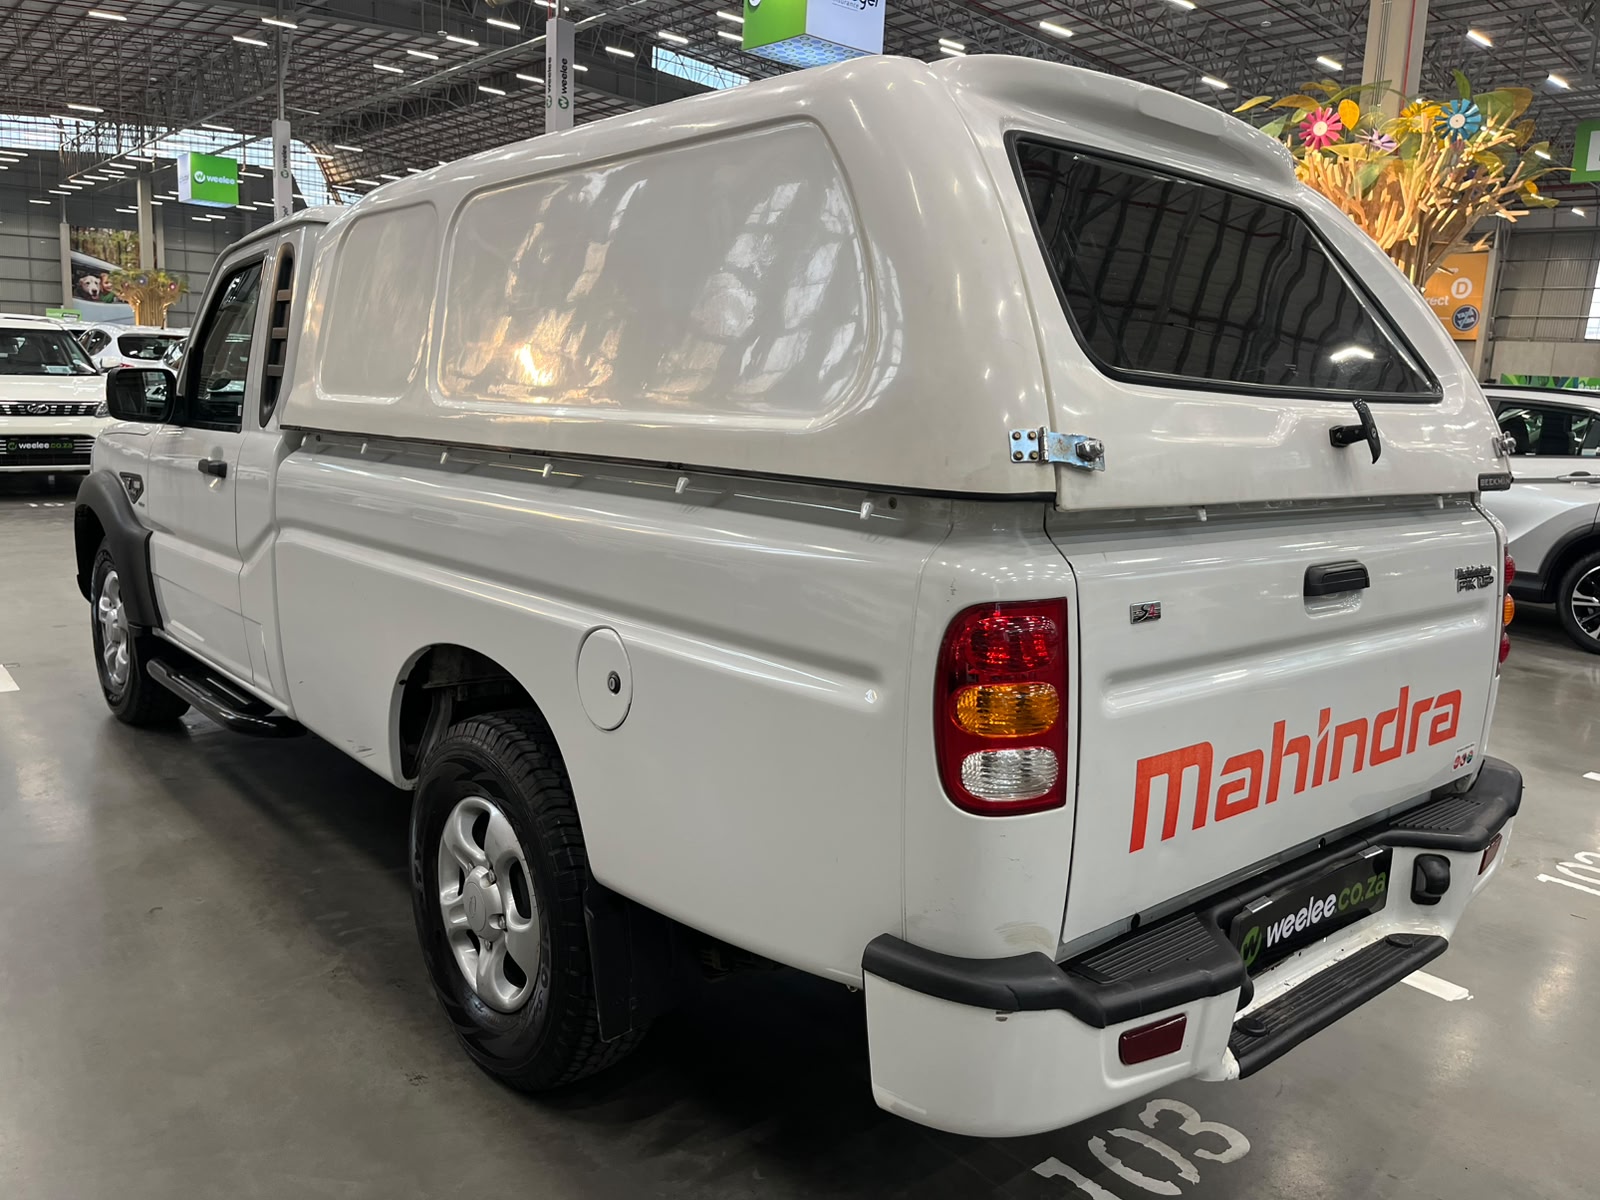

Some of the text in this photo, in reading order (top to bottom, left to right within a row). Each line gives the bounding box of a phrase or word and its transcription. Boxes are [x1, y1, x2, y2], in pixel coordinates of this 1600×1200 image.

[560, 58, 568, 94] weelee
[206, 176, 235, 185] weelee
[1129, 685, 1462, 853] Mahindra
